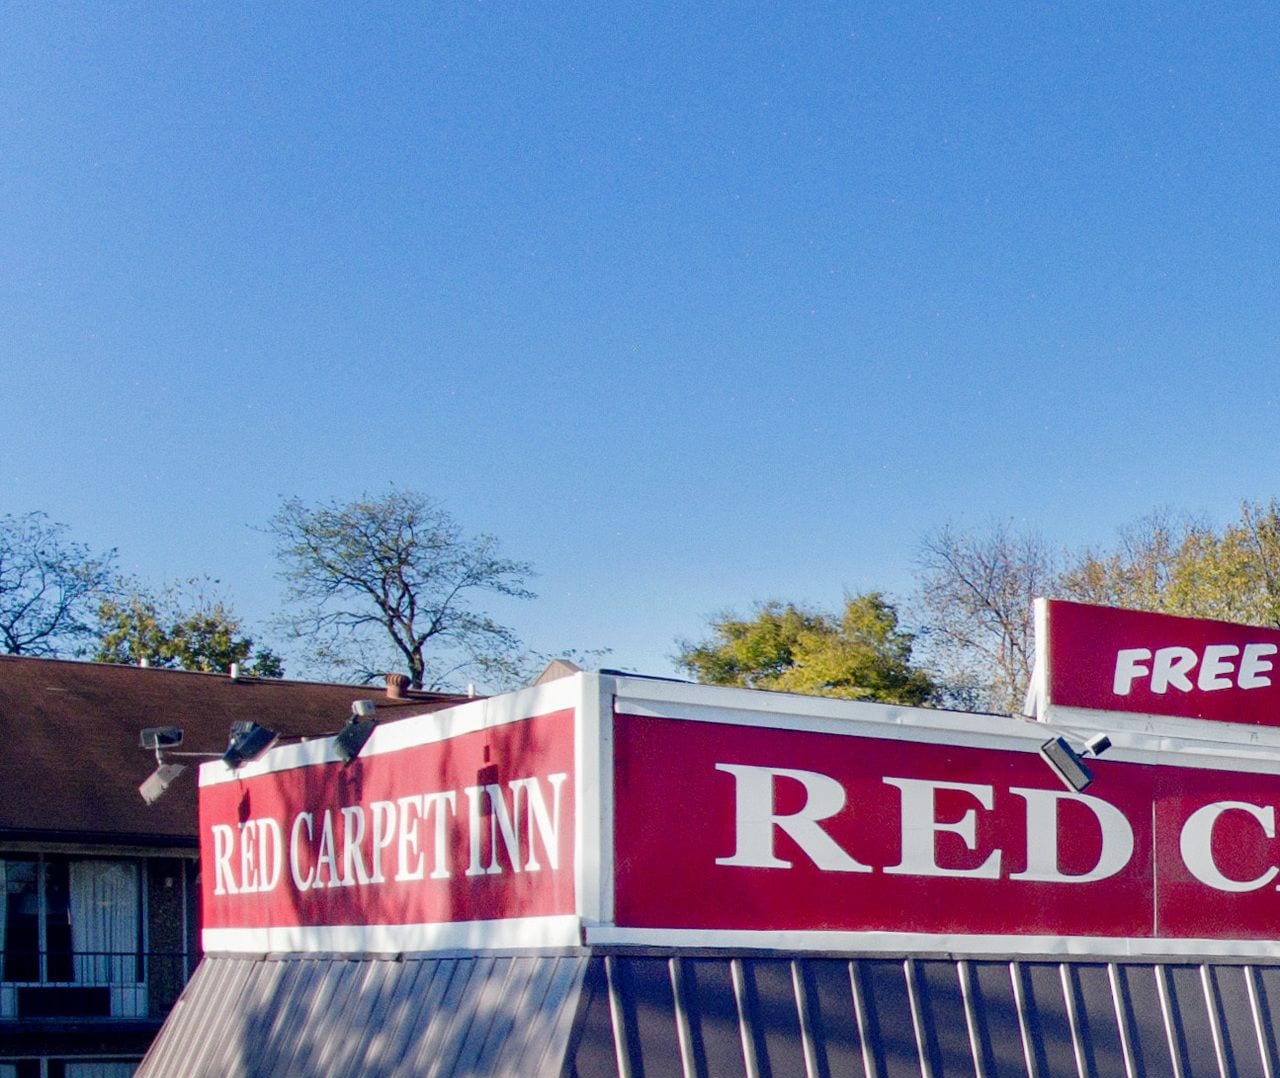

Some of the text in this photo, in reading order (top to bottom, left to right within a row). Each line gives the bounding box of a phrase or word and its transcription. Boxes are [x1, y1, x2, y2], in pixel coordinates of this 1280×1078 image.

[1112, 643, 1278, 696] FREE
[211, 772, 569, 897] RED CARPET INN
[715, 762, 1136, 884] RED
